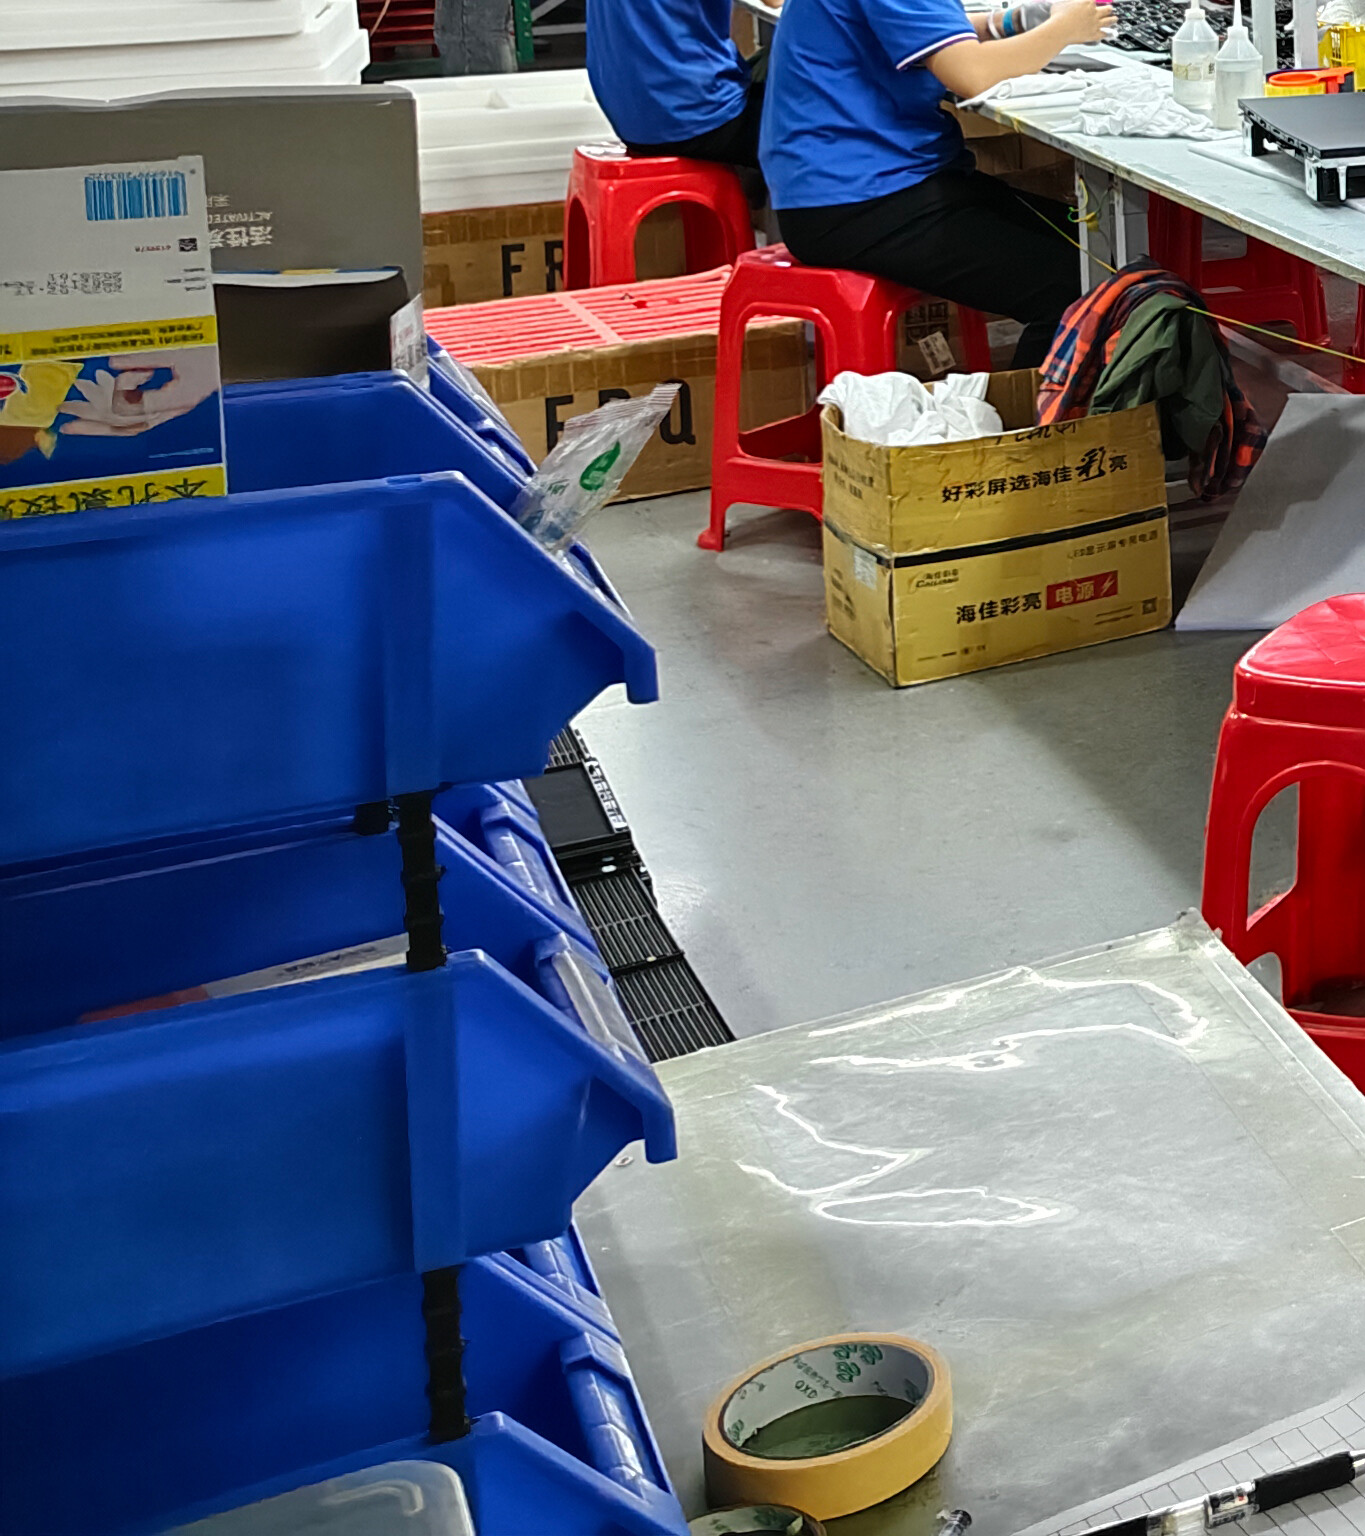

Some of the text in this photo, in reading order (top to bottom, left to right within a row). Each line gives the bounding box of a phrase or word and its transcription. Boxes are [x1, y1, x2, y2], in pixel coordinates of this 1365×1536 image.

[545, 379, 696, 455] FQ
[941, 446, 1128, 504] 好彩屏选海佳彩亮
[956, 580, 1095, 625] 海佳彩亮 电源
